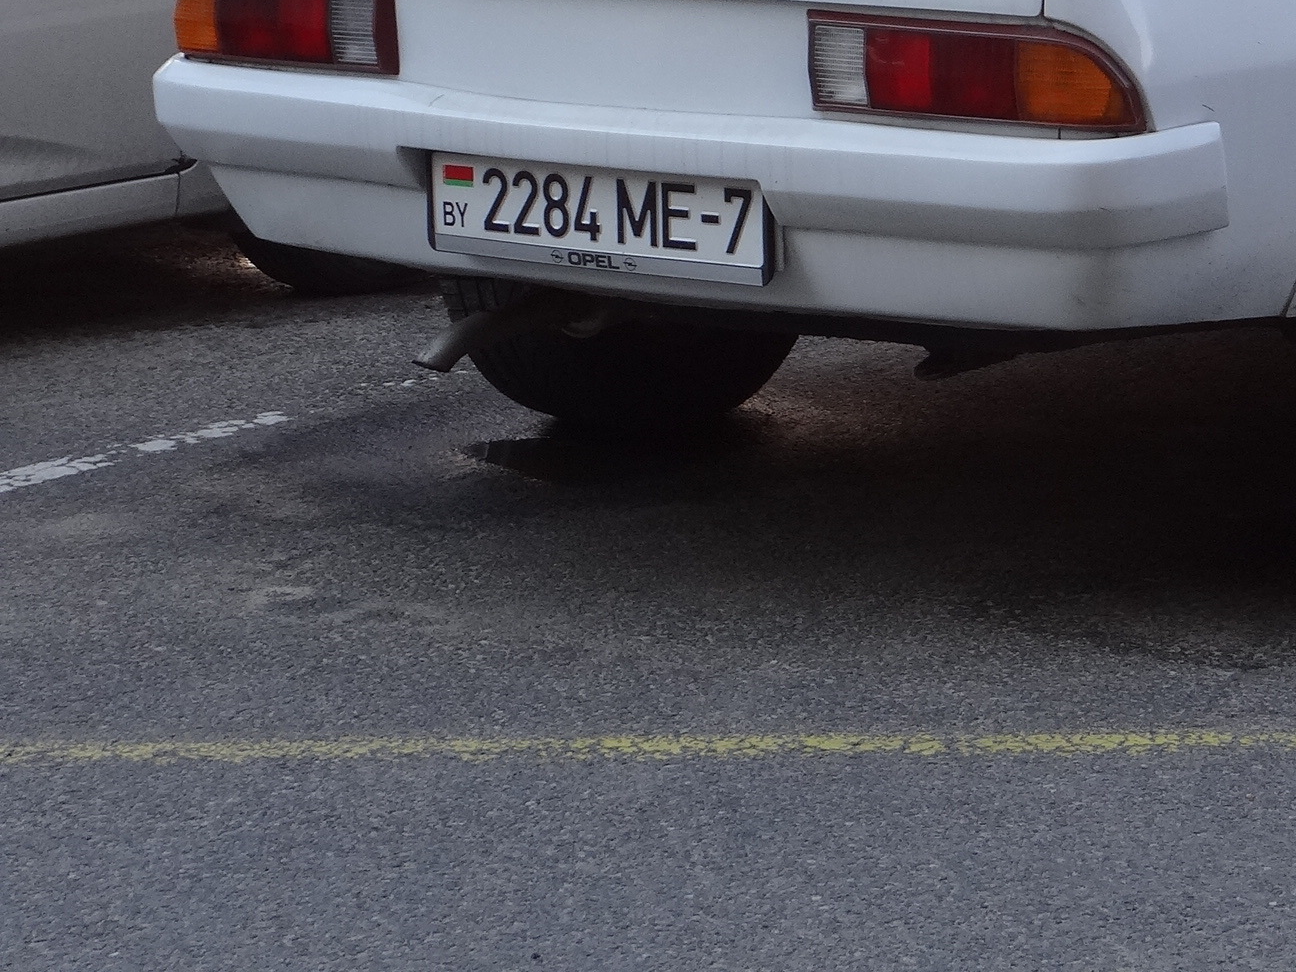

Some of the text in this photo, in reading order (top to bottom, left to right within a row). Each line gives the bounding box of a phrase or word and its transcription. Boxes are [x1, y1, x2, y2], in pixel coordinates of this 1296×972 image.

[443, 201, 468, 227] BY
[482, 168, 753, 254] 2284 ME-7
[567, 251, 620, 270] OPEL
